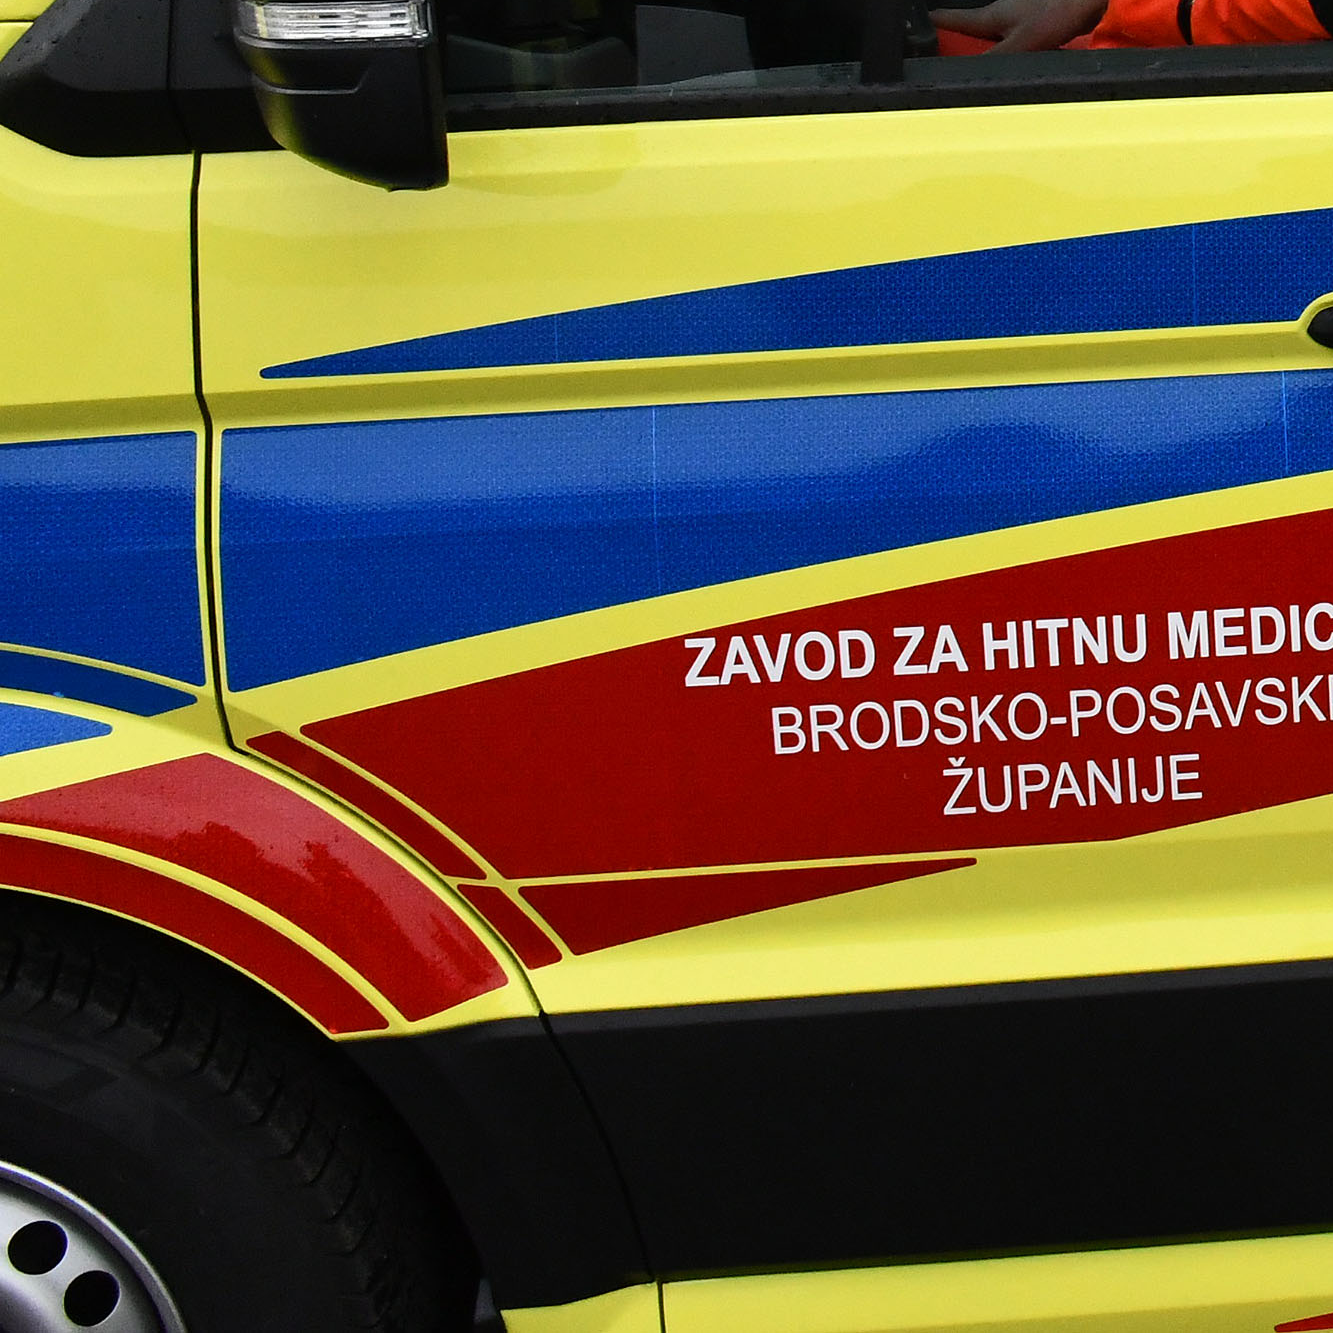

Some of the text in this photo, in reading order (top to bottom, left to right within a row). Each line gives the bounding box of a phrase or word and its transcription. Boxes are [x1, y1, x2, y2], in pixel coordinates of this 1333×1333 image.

[684, 629, 876, 687] ZAVOD
[893, 624, 969, 676] ZA
[982, 613, 1147, 671] HITNU
[942, 753, 1203, 816] ŽUPANIJE
